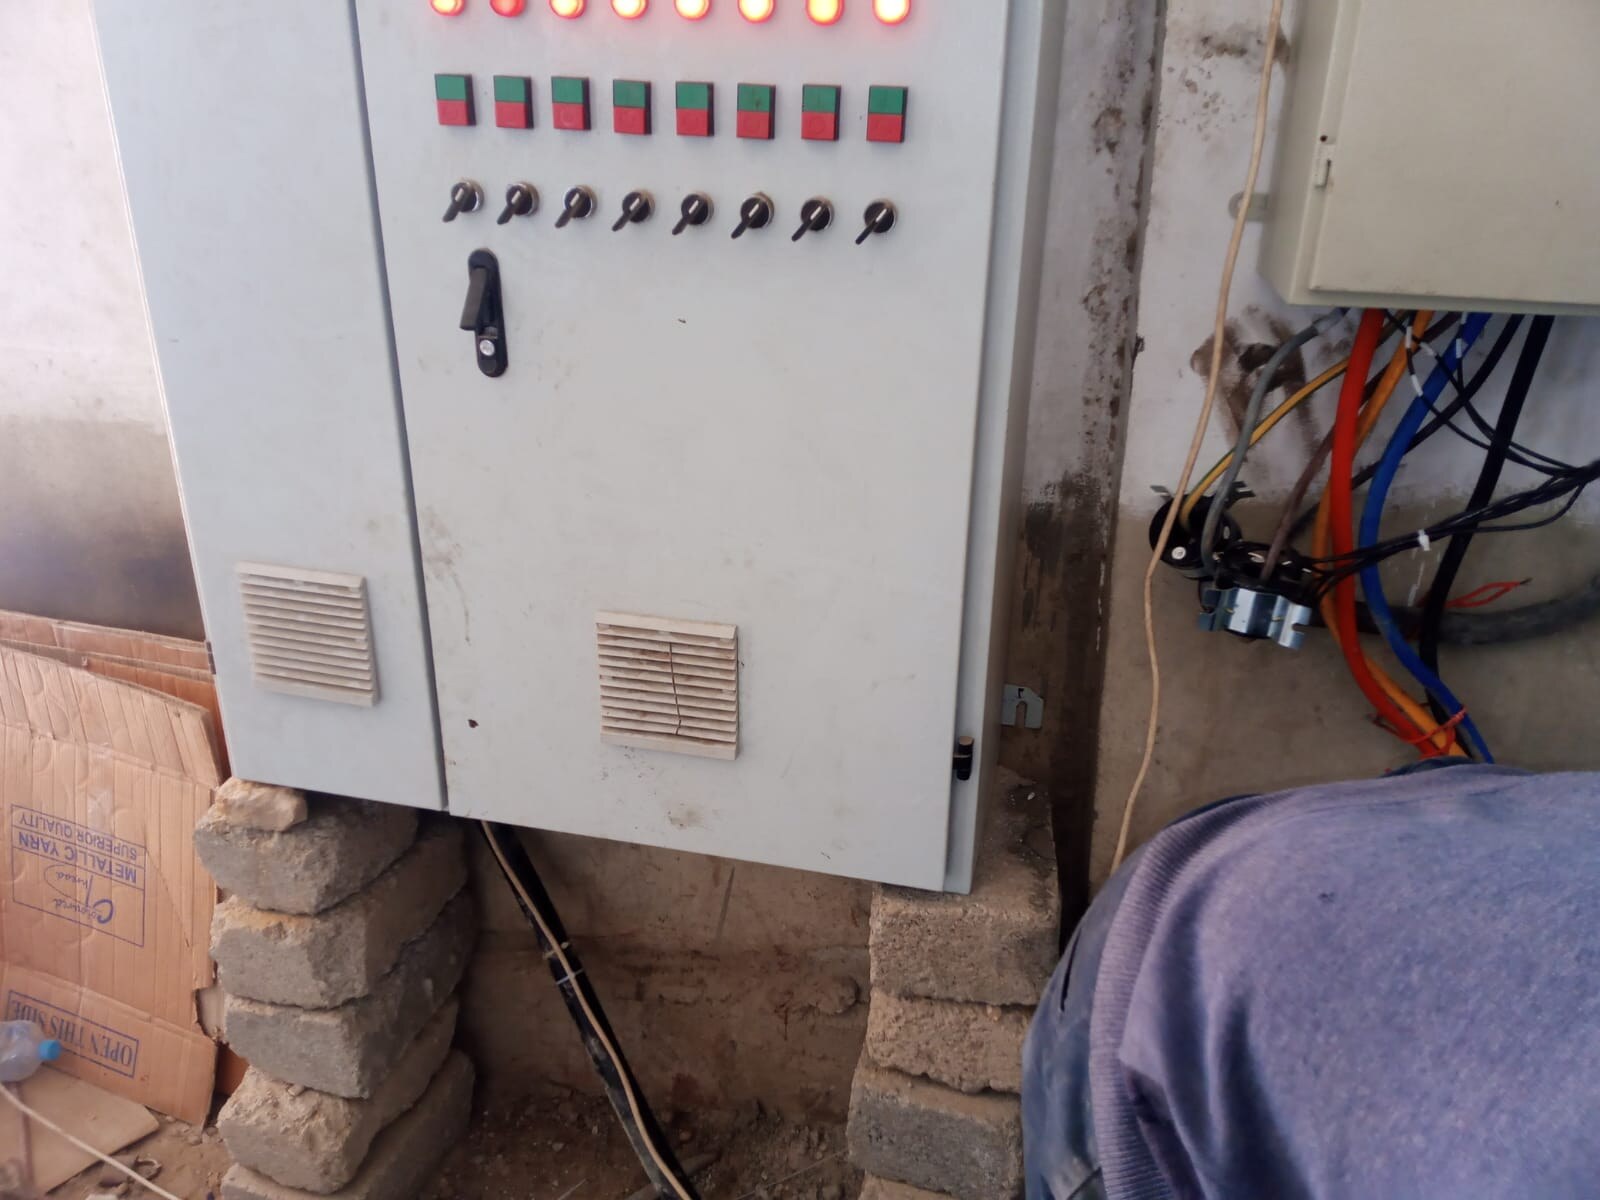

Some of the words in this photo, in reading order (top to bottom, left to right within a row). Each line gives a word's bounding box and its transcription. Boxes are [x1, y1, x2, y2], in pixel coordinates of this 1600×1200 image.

[19, 813, 73, 839] QUALITY
[18, 831, 60, 857] YARN
[76, 830, 137, 861] SUPERIOR
[64, 846, 137, 884] METALLIC
[50, 1016, 85, 1050] THIS
[91, 1033, 133, 1067] OPEN
